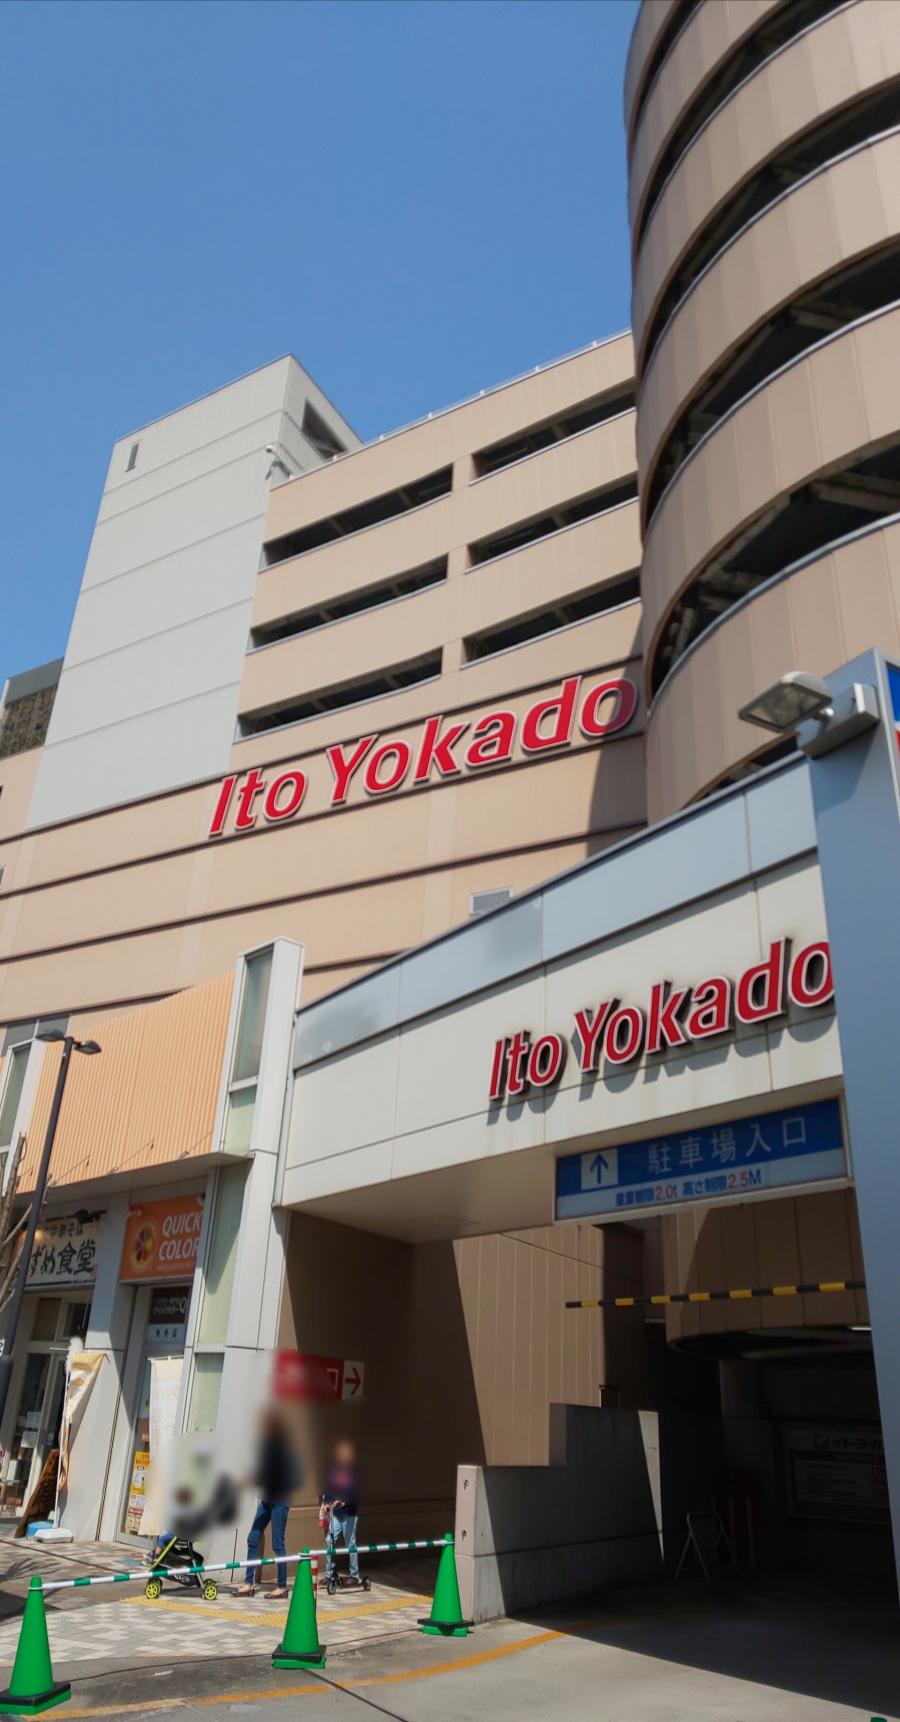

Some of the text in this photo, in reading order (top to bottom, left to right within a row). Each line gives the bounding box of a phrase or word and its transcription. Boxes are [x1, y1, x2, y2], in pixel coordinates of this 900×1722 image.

[208, 674, 639, 837] Ito Yokado
[488, 937, 835, 1100] Ito Yokado
[647, 1116, 807, 1176] 駐車場入口
[162, 1211, 203, 1238] QUICK
